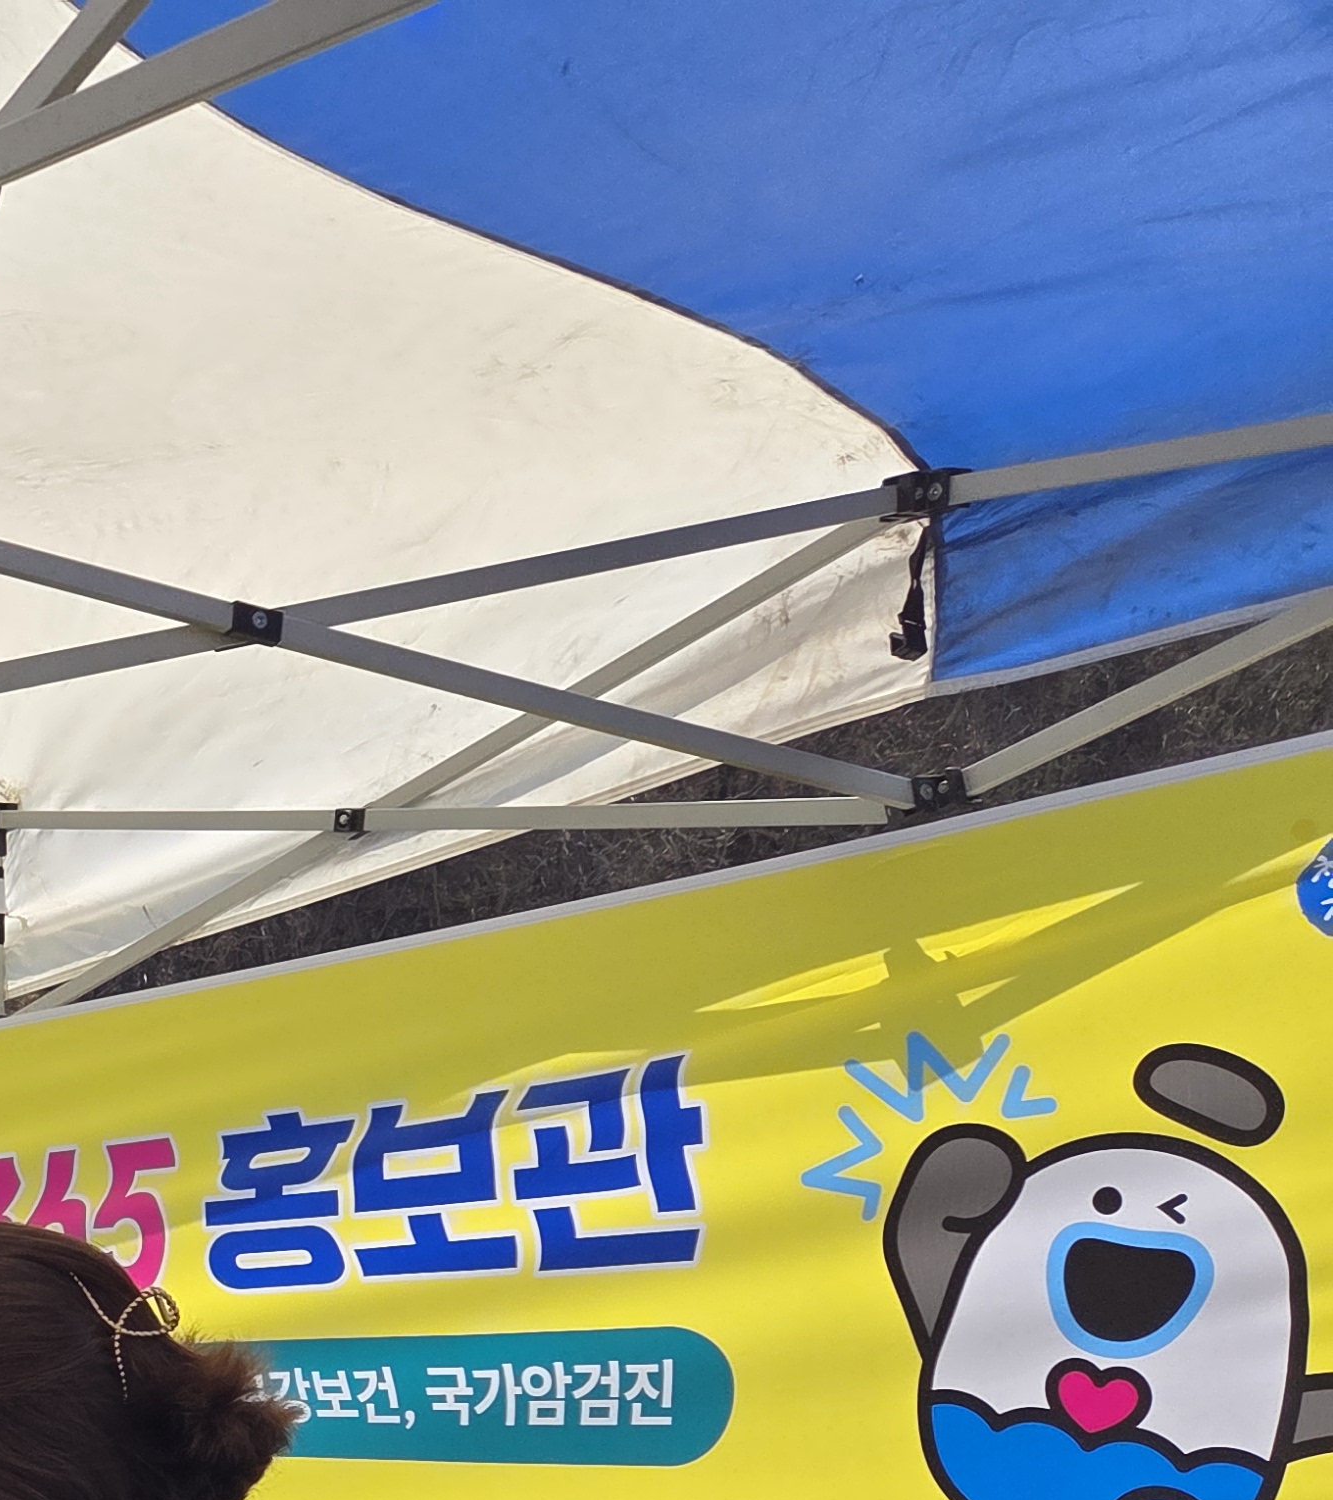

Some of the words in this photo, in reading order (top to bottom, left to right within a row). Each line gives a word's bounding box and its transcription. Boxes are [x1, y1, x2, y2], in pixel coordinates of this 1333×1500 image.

[203, 1054, 704, 1291] 홍보관
[247, 1366, 416, 1430] 강보건,
[425, 1358, 674, 1426] 국가암검진
